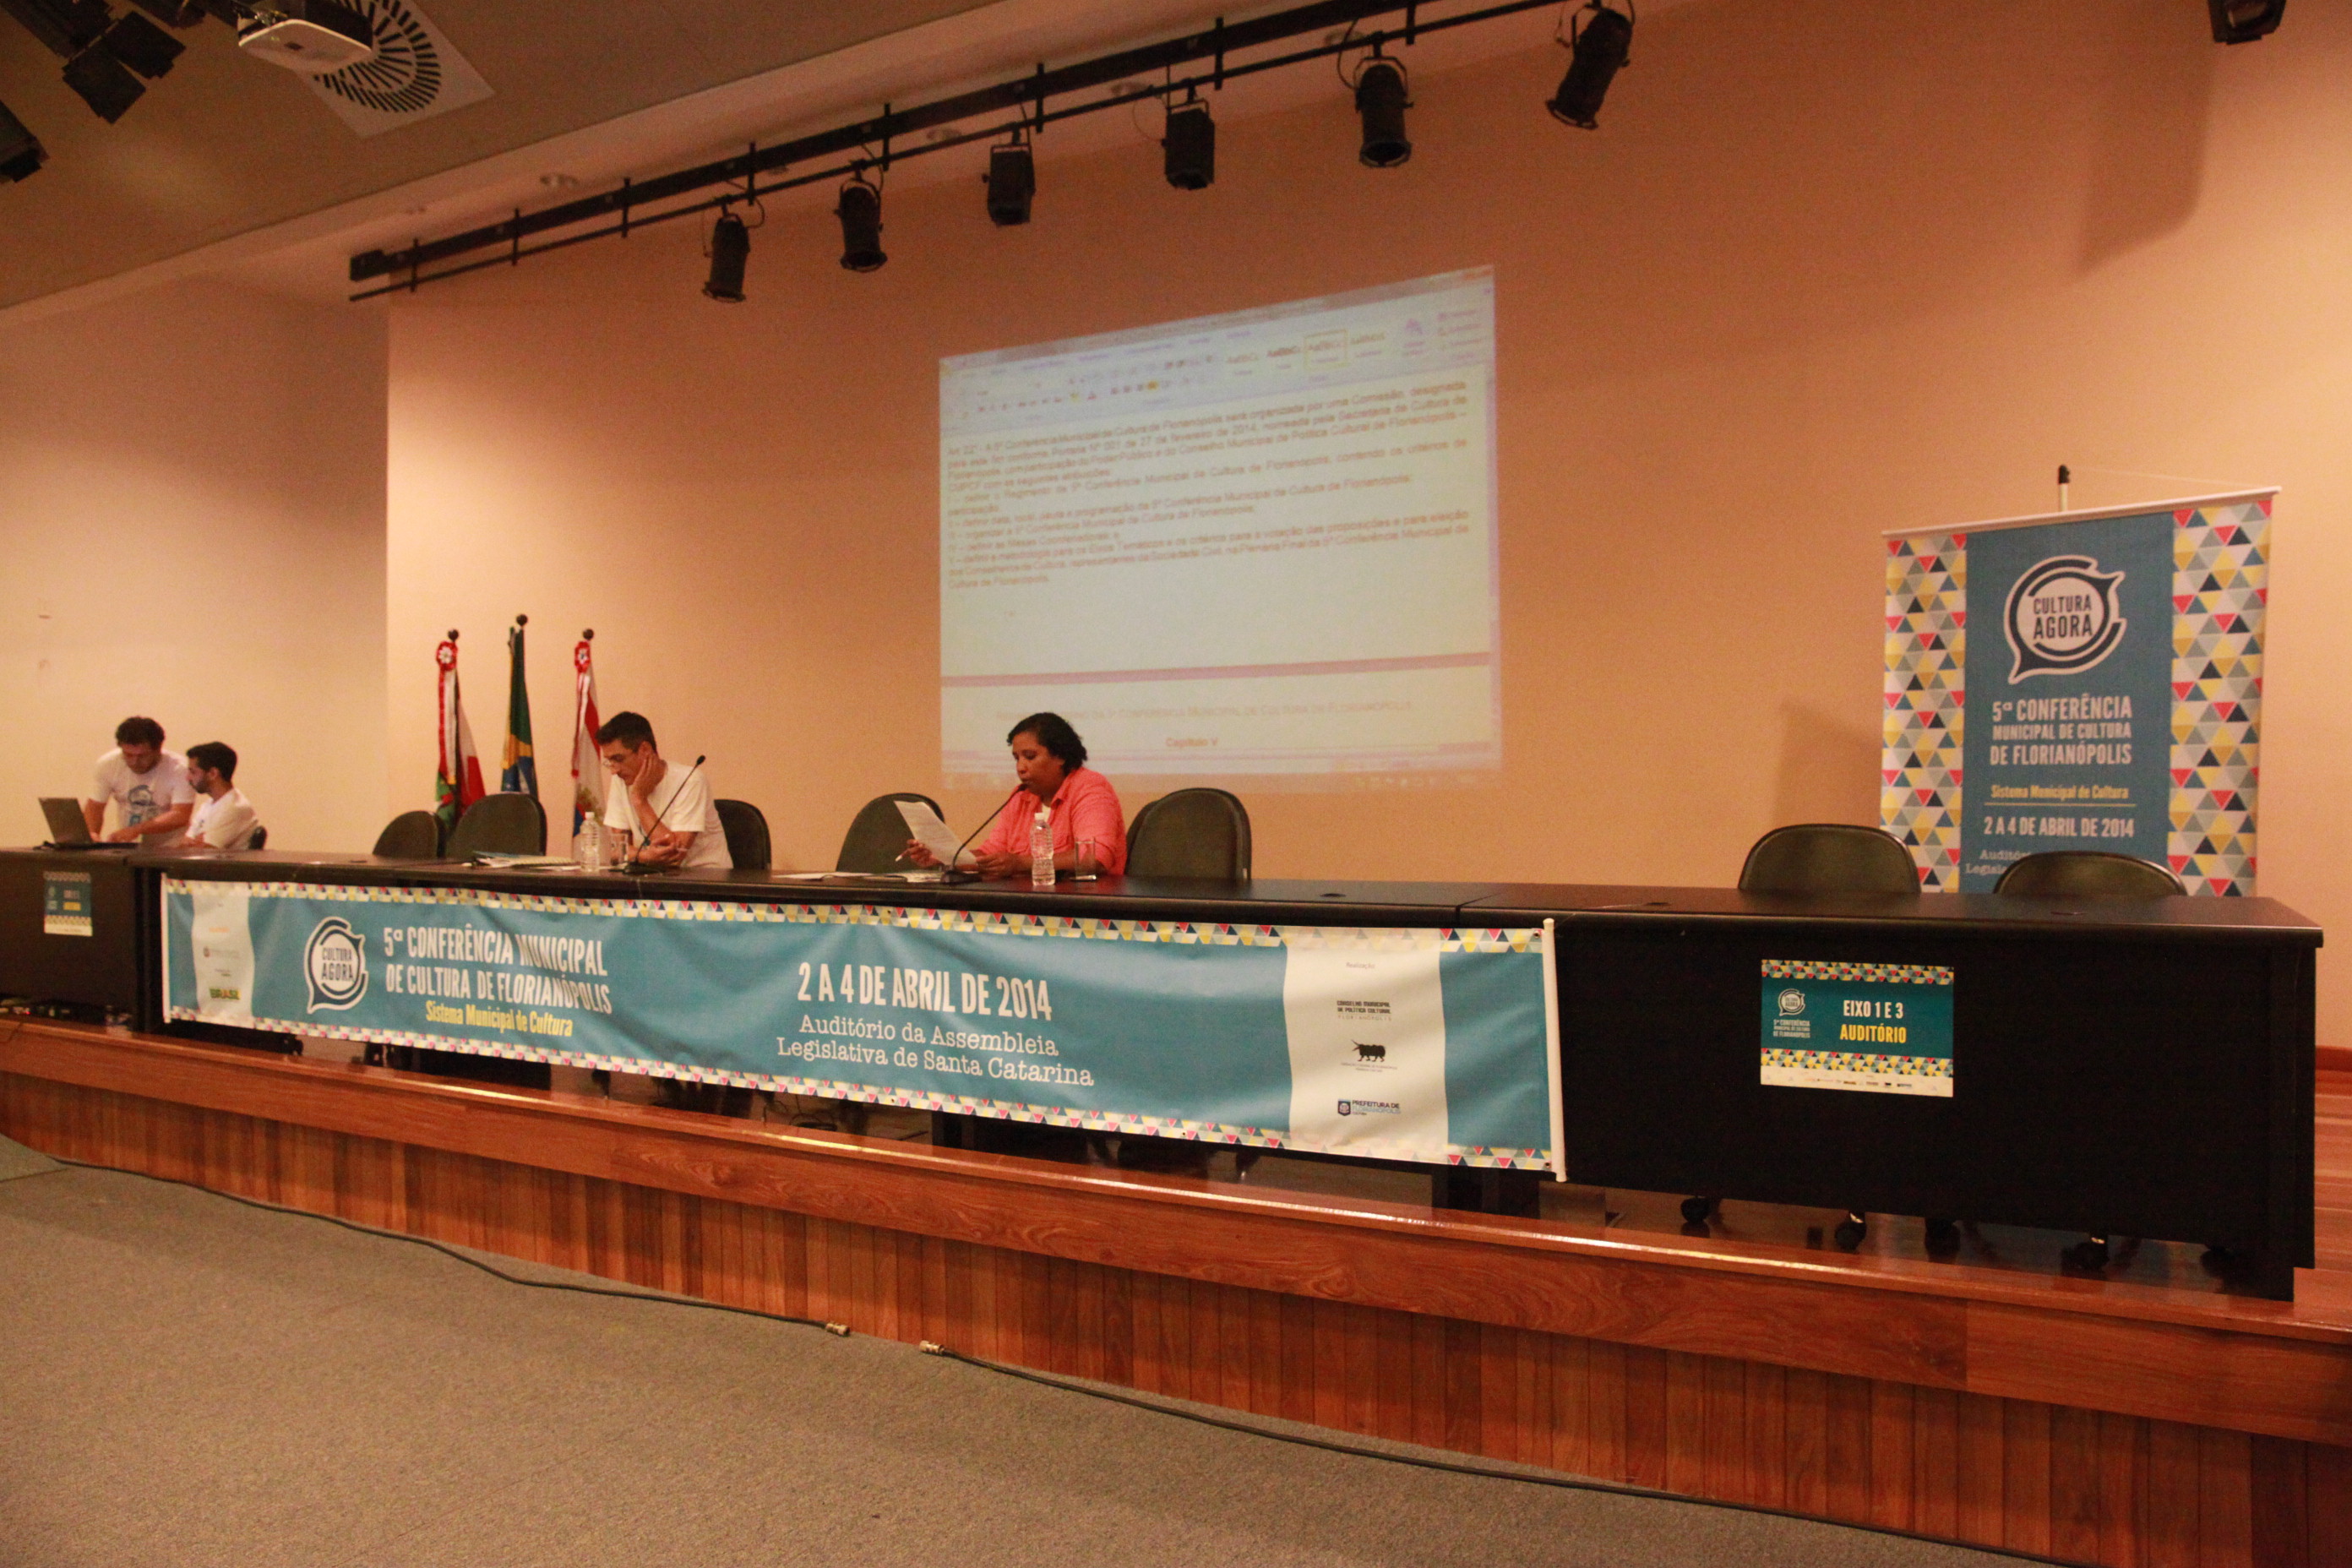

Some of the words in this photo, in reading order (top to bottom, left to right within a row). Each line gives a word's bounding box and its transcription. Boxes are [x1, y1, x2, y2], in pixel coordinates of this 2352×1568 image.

[2033, 594, 2093, 615] CULTURA
[2033, 614, 2093, 640] AGORA
[2017, 693, 2132, 721] CONFERÊNCIA
[1992, 724, 2055, 742] MUNICIPAL
[2059, 724, 2074, 740] DE
[2077, 721, 2132, 740] CULTURA
[1990, 746, 2010, 766] DE
[2012, 740, 2132, 765] FLORIANÓPOLIS
[1990, 784, 2028, 799] Sistema
[2031, 784, 2077, 803] Municipal
[2078, 785, 2090, 800] de
[2092, 784, 2129, 800] Cultura
[1984, 817, 1992, 835] 2
[1995, 817, 2006, 835] A
[2006, 817, 2018, 836] 4
[2020, 817, 2036, 836] DE
[2039, 817, 2077, 837] ABRIL
[2081, 818, 2099, 837] DE
[2101, 818, 2135, 838] 2014
[322, 946, 352, 962] CULTURA
[407, 923, 514, 966] CONFERÊNCIA
[515, 933, 608, 977] MUNICIPAL
[321, 962, 354, 982] AGORA
[385, 964, 404, 993] DE
[407, 965, 471, 999] CULTURA
[477, 971, 495, 1001] DE
[498, 972, 612, 1015] FLORIANÓPOLIS
[798, 961, 811, 1001] 2
[818, 963, 835, 1002] A
[840, 965, 854, 1003] 4
[859, 965, 886, 1006] DE
[892, 967, 956, 1012] ABRIL
[961, 972, 992, 1015] DE
[996, 976, 1053, 1021] 2014
[426, 1000, 464, 1024] Sistema
[466, 1004, 514, 1033] Municipal
[516, 1014, 528, 1032] de
[530, 1013, 574, 1037] Cultura
[1843, 1000, 1871, 1017] EIXO
[1875, 1001, 1881, 1018] 1
[1885, 1002, 1892, 1018] E
[1895, 1002, 1903, 1019] 3
[798, 1015, 896, 1042] Auditório
[901, 1021, 926, 1044] da
[930, 1026, 1059, 1057] Assembleia
[1839, 1023, 1907, 1043] AUDITÓRIO
[776, 1037, 888, 1065] Legislativa
[894, 1047, 918, 1068] de
[924, 1050, 983, 1077] Santa
[988, 1057, 1095, 1087] Catarina
